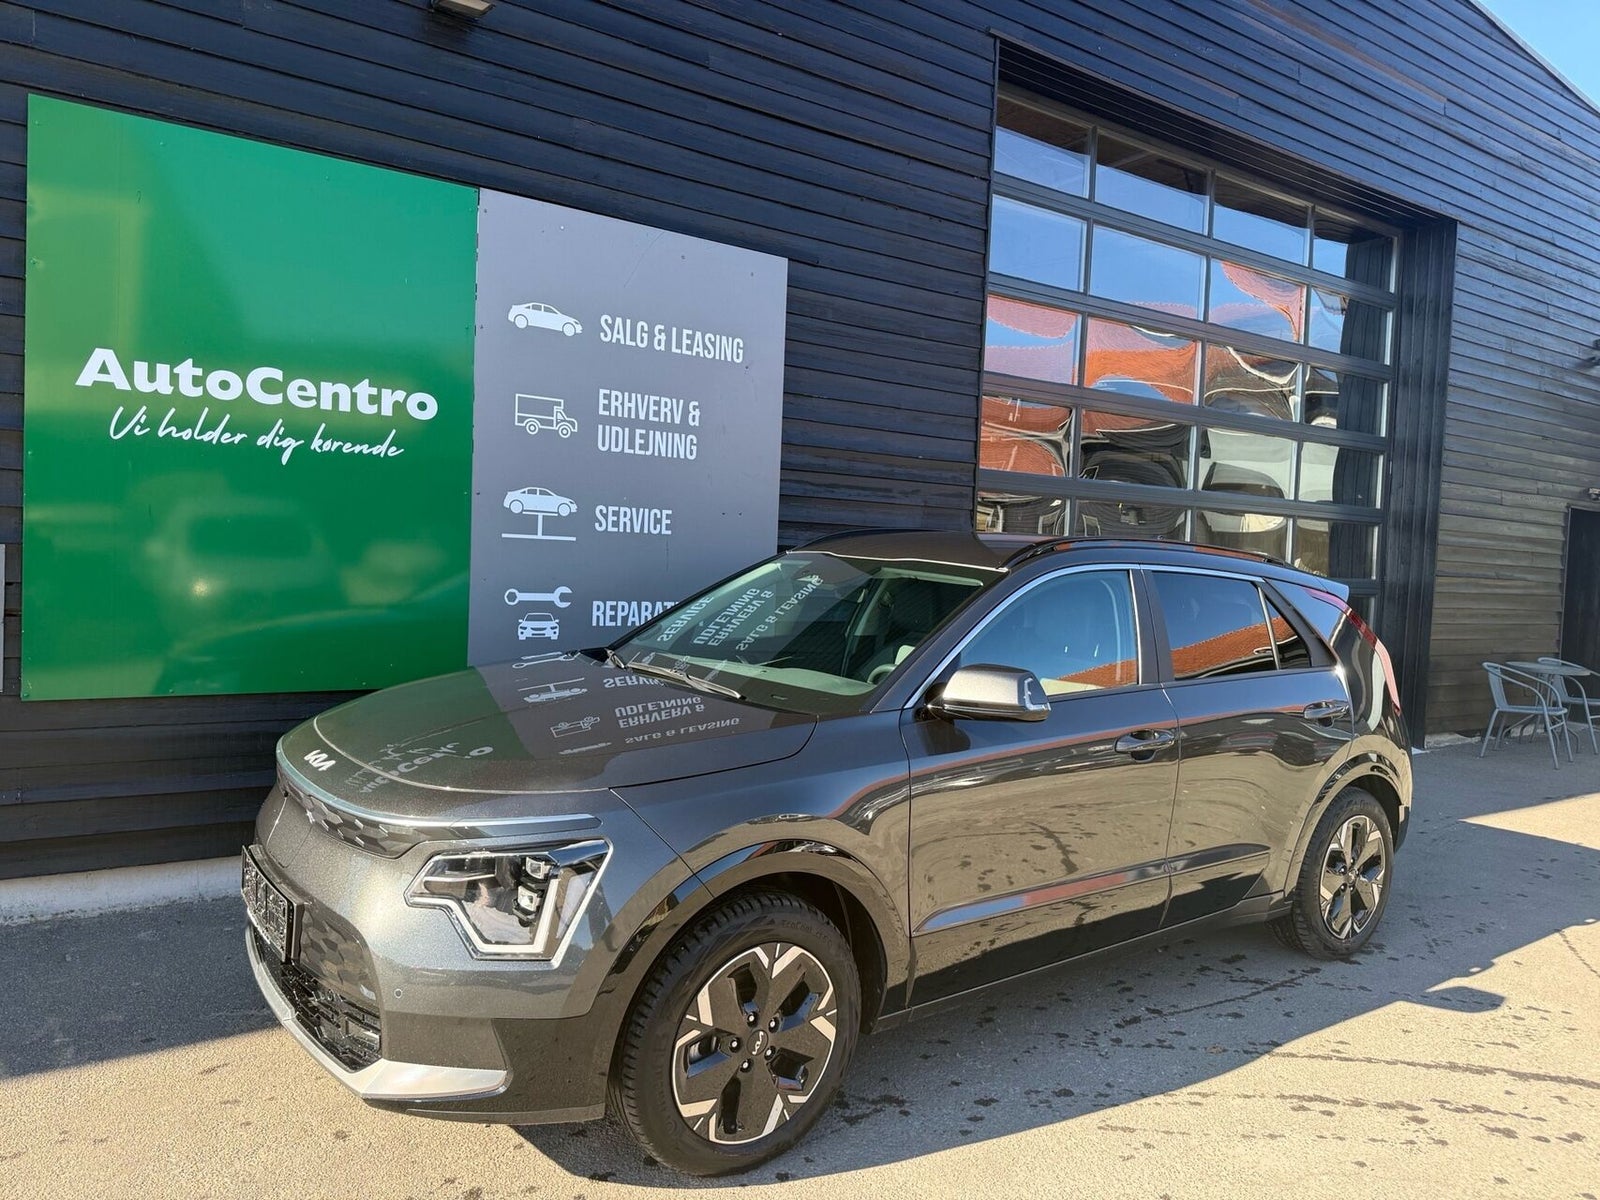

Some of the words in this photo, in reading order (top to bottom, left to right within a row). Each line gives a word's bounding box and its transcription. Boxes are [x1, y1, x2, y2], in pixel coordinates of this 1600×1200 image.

[600, 315, 649, 348] SALG
[653, 325, 667, 351] &
[671, 327, 744, 364] LEASING
[75, 347, 438, 421] AutoCentro
[598, 389, 684, 425] ERHVERV
[688, 400, 701, 427] &
[110, 405, 151, 440] Vi
[157, 407, 248, 445] holder
[256, 419, 304, 465] dig
[310, 423, 404, 458] kørende
[597, 425, 698, 460] UDLEJNING
[594, 505, 673, 535] SERVICE
[591, 600, 679, 627] REPARAT
